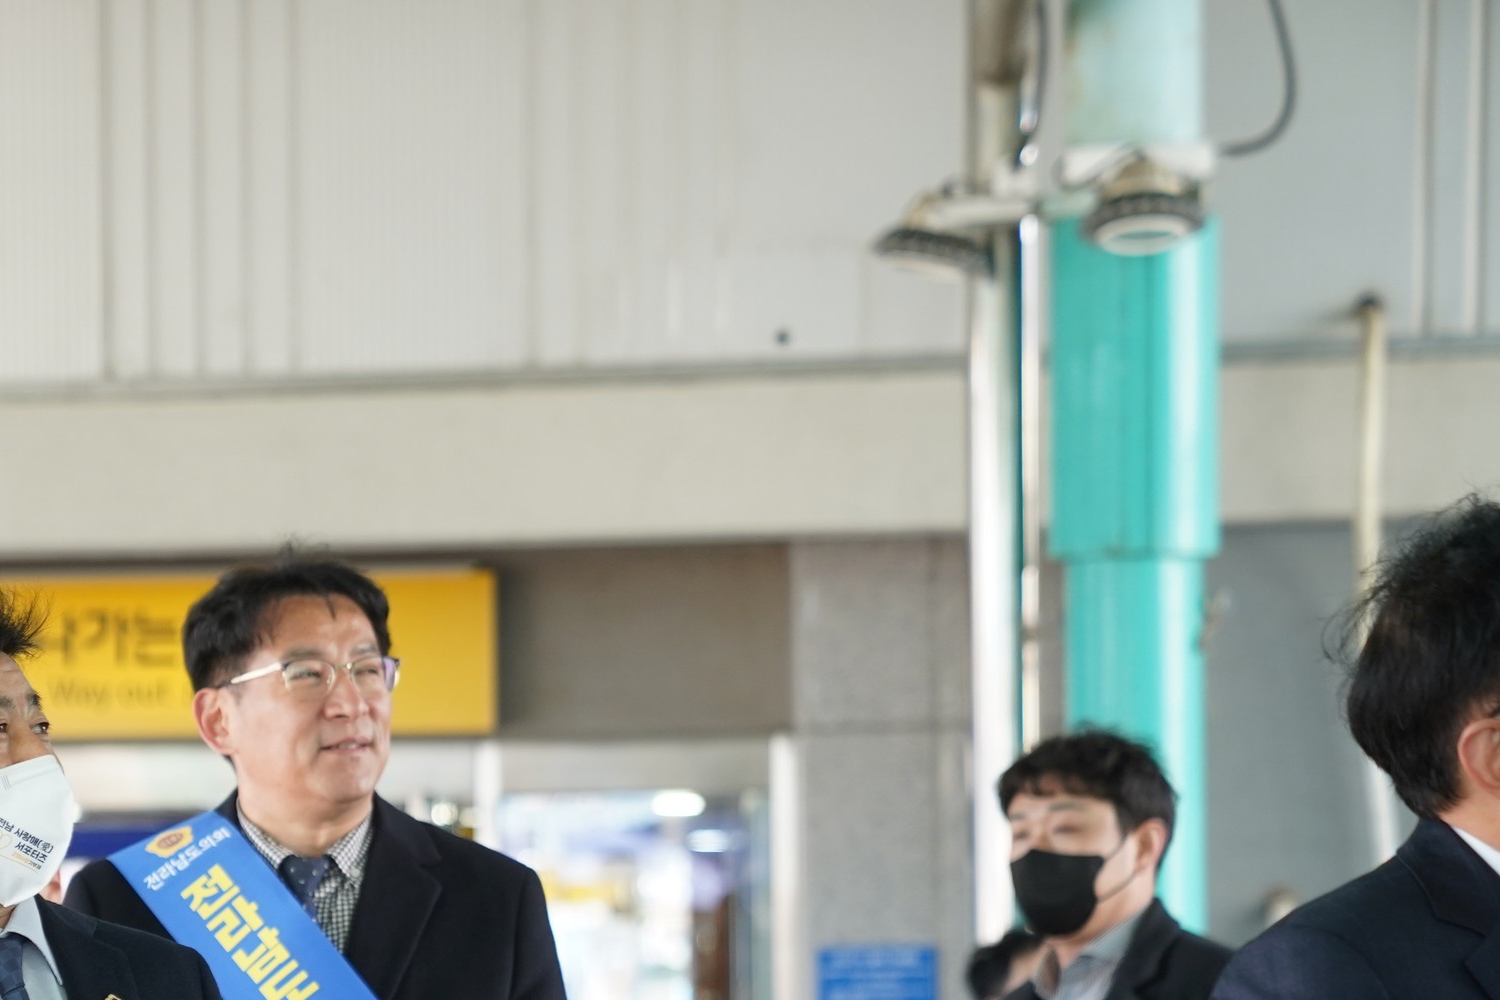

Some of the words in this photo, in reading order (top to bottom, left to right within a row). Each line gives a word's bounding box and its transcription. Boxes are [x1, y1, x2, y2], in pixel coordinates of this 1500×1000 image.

[47, 675, 108, 708] Way
[114, 677, 167, 707] out
[14, 841, 48, 863] 서포터즈
[143, 827, 231, 890] 전라남도의회
